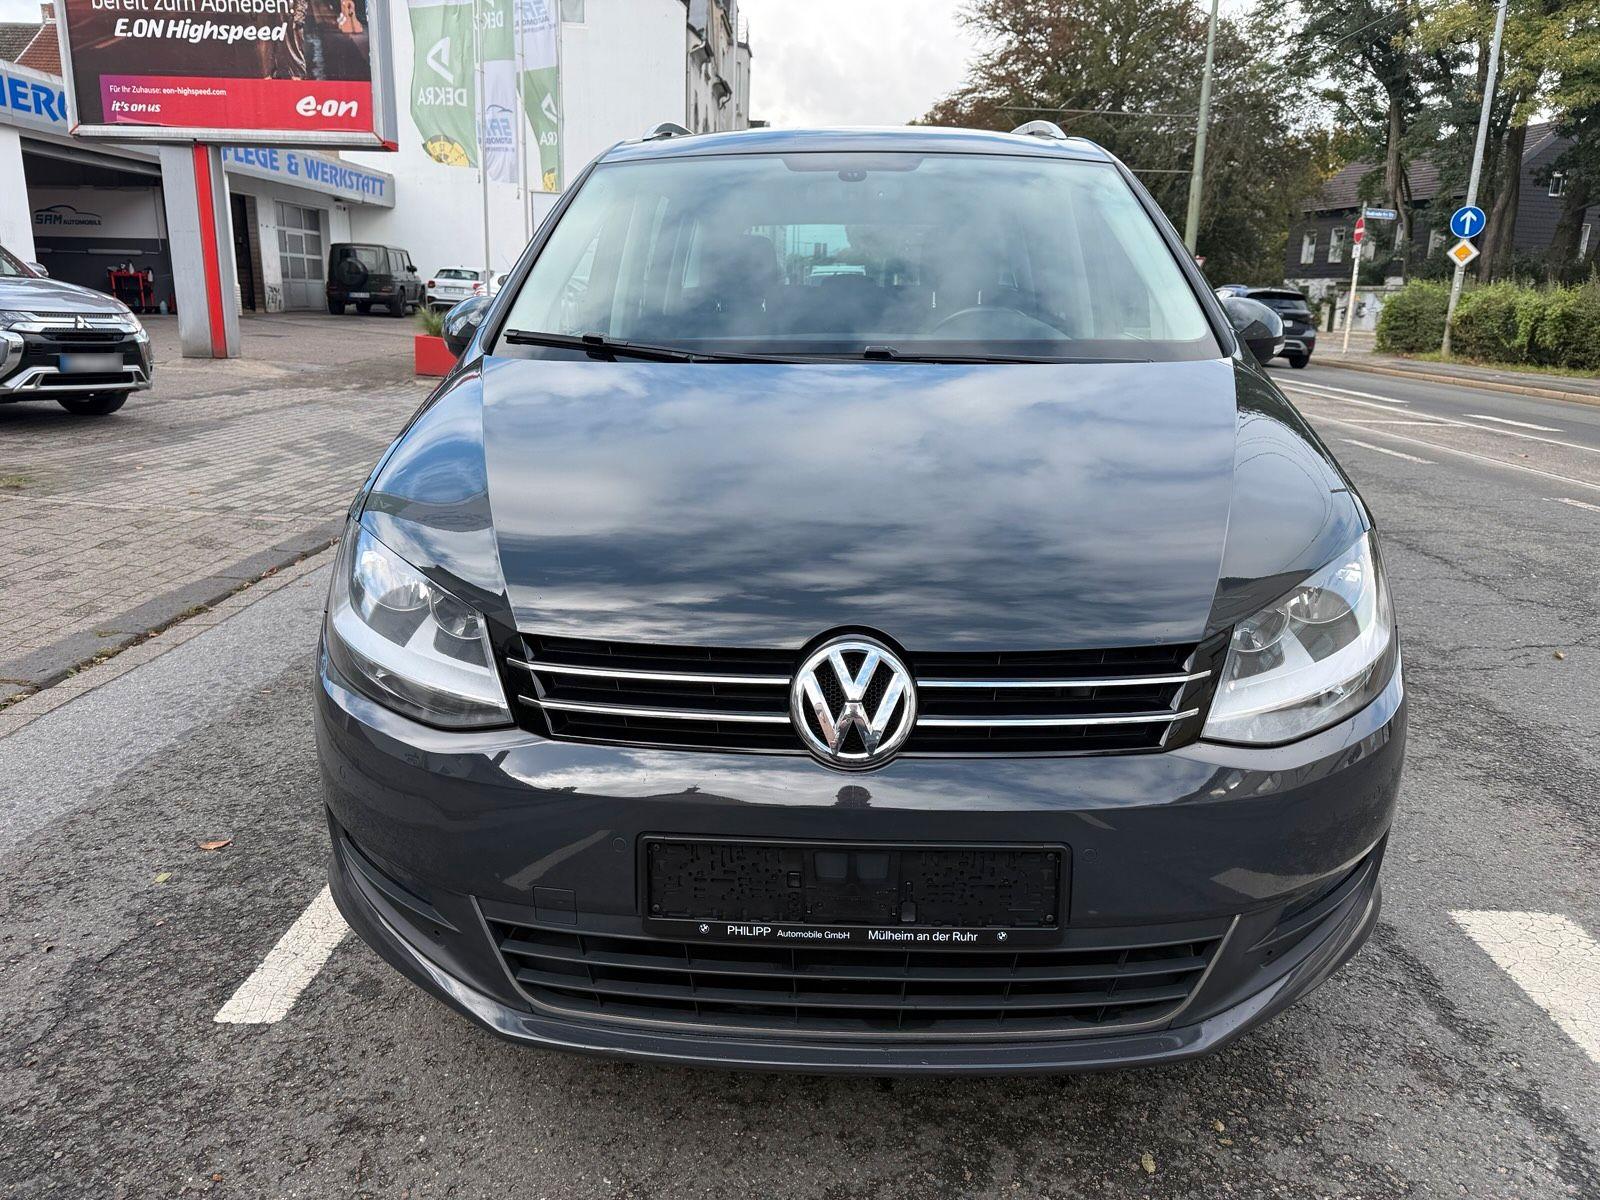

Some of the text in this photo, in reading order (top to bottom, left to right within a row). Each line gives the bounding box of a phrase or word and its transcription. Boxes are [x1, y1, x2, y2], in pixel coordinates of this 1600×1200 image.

[154, 0, 196, 11] zum
[114, 18, 288, 44] E.ON Highspeed
[109, 84, 227, 97] Für Ihr Zuhause: eon-highspeed.com
[130, 103, 147, 112] on
[147, 103, 161, 113] us
[287, 153, 299, 176] &
[303, 158, 385, 197] WERKSTATT
[34, 214, 62, 225] SAM
[727, 925, 850, 940] PHILIPP Automobile GmbH
[868, 930, 978, 942] Mülheim an der Ruhr
